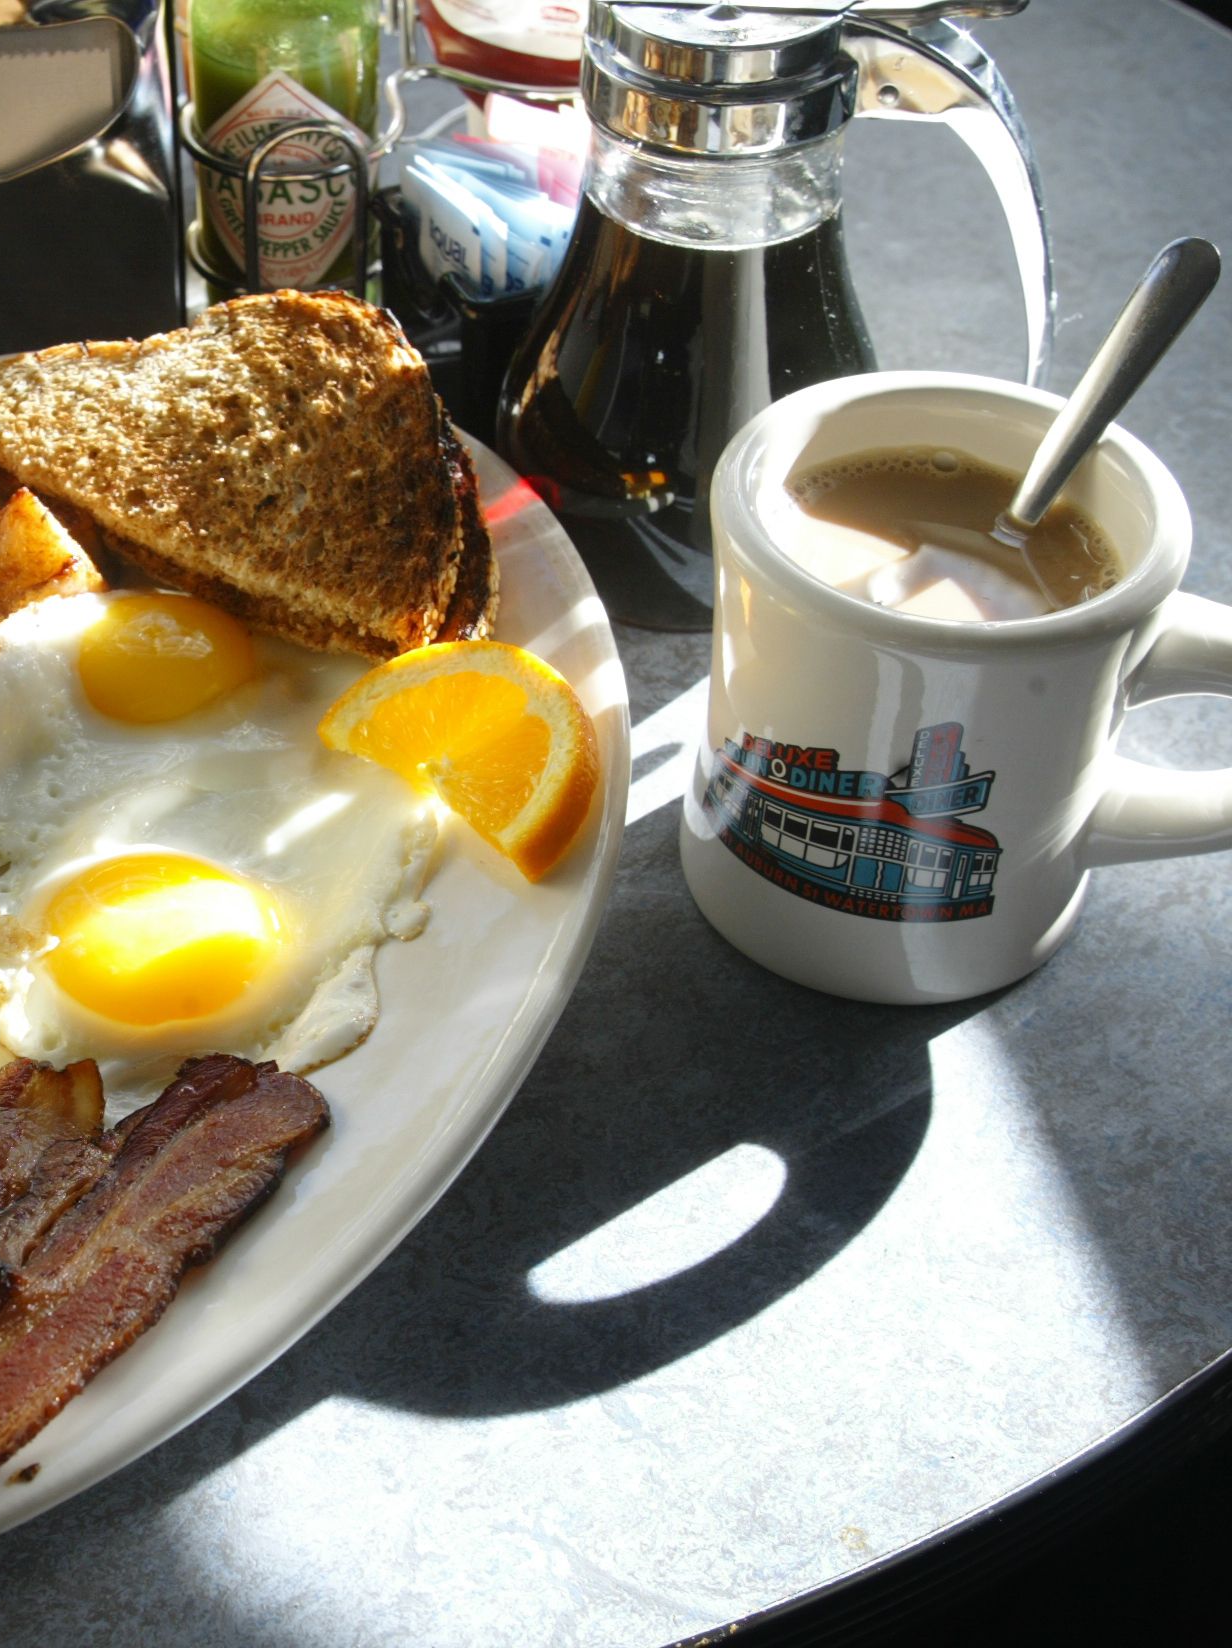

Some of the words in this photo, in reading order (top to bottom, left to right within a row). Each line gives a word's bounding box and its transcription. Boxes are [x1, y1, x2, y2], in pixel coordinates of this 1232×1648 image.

[742, 731, 838, 772] DELUXE
[911, 730, 930, 787] DELUXE
[788, 766, 882, 799] DINER
[910, 786, 980, 813] DINER
[735, 842, 799, 892] AUBURN
[823, 889, 954, 921] WATERTOWN
[959, 902, 989, 917] MA
